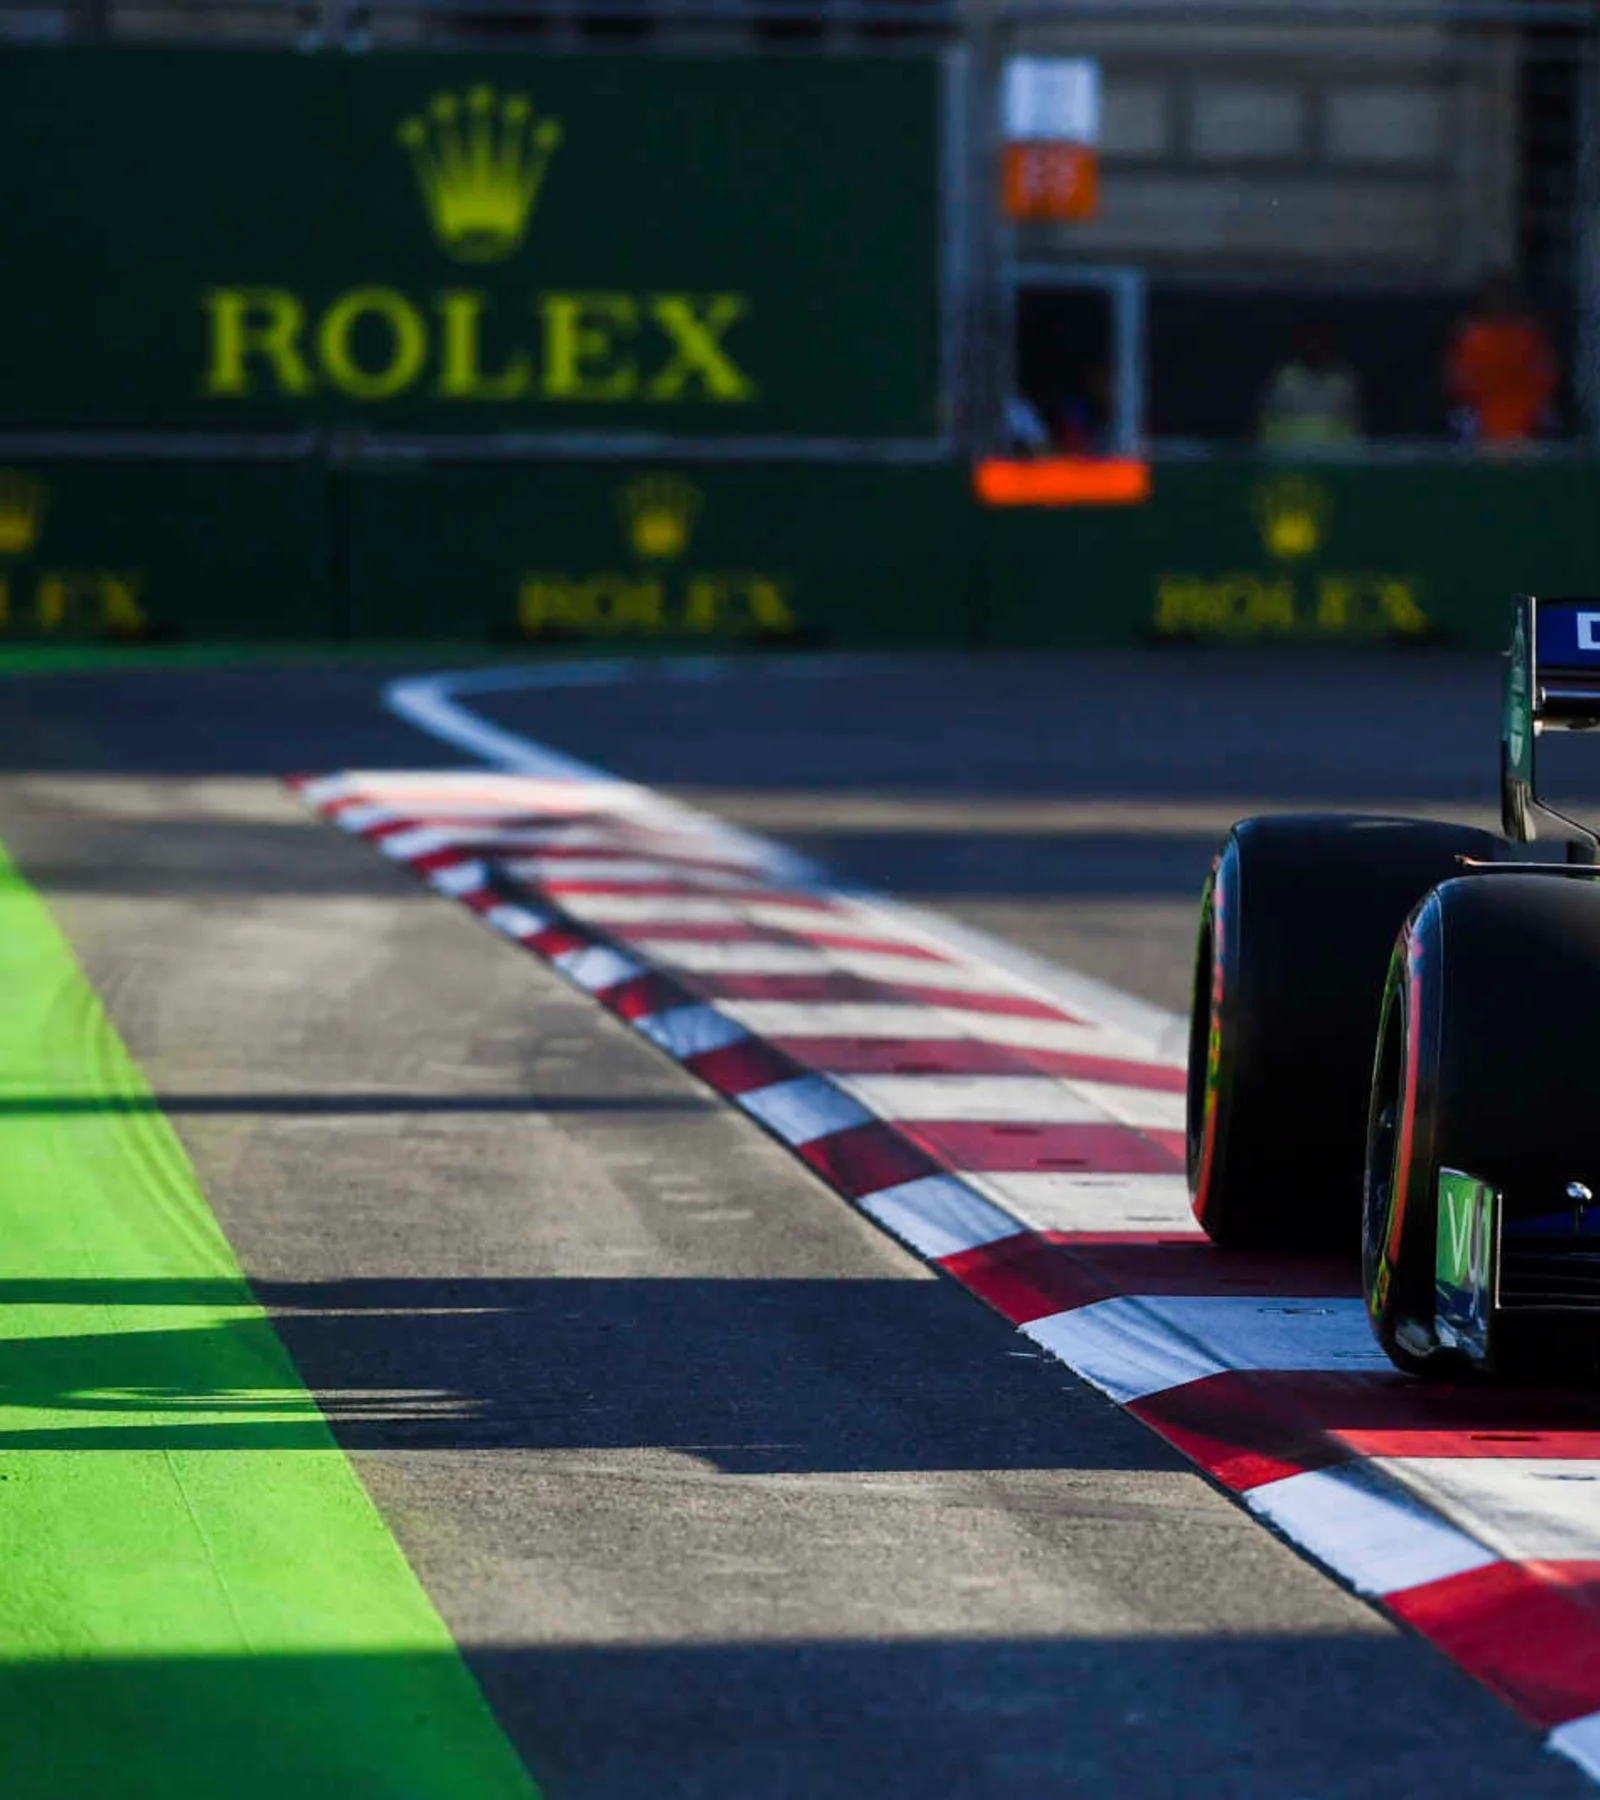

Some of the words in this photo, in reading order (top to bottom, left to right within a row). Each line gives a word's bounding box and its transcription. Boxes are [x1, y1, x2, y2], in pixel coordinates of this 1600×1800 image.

[205, 285, 755, 401] ROLEX
[519, 573, 796, 632] ROLEX
[1157, 574, 1428, 633] ROLEX
